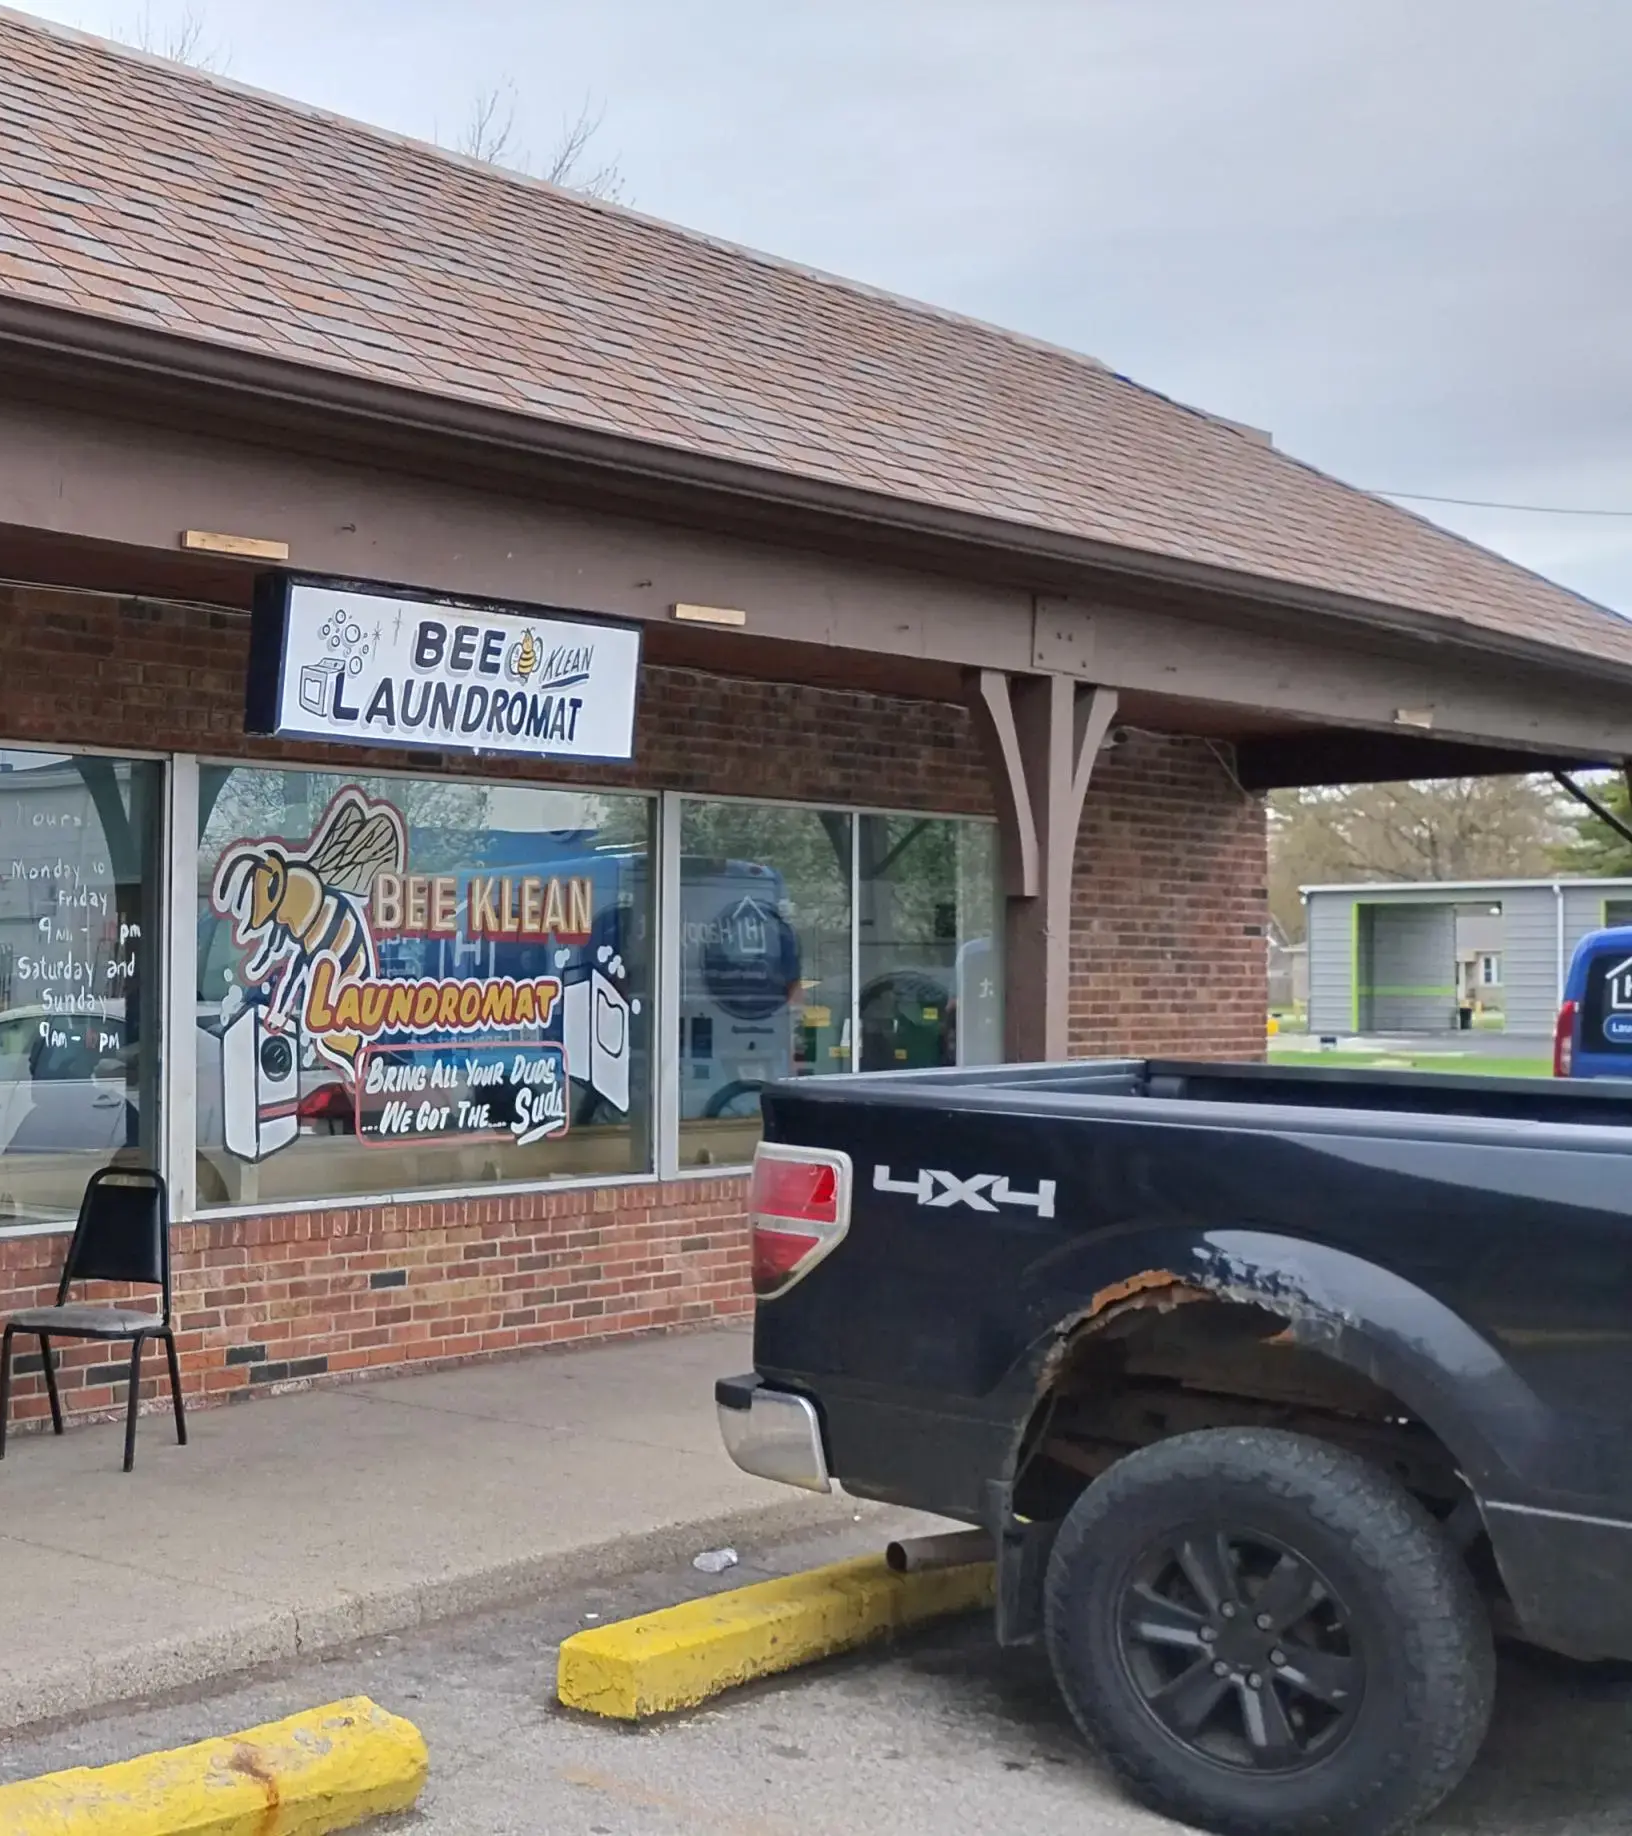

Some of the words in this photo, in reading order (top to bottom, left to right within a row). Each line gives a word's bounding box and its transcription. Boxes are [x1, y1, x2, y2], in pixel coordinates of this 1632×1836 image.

[413, 620, 507, 674] BEE
[543, 644, 594, 681] KLEAN
[332, 672, 583, 741] LAUNDROMAT
[11, 857, 81, 890] Monday
[58, 884, 108, 916] Friday
[372, 872, 459, 932] BEE
[469, 876, 594, 936] KLEAN
[17, 949, 95, 988] Saturday
[107, 951, 136, 979] and
[41, 985, 107, 1023] Sunday
[306, 963, 562, 1033] LAUNDROMAT
[365, 1056, 426, 1095] BRING
[430, 1058, 459, 1089] ALL
[465, 1056, 505, 1089] YOUR
[509, 1054, 556, 1085] DUDS
[415, 1100, 452, 1132] GOT
[510, 1081, 567, 1135] Suds
[873, 1164, 1057, 1217] 4X4
